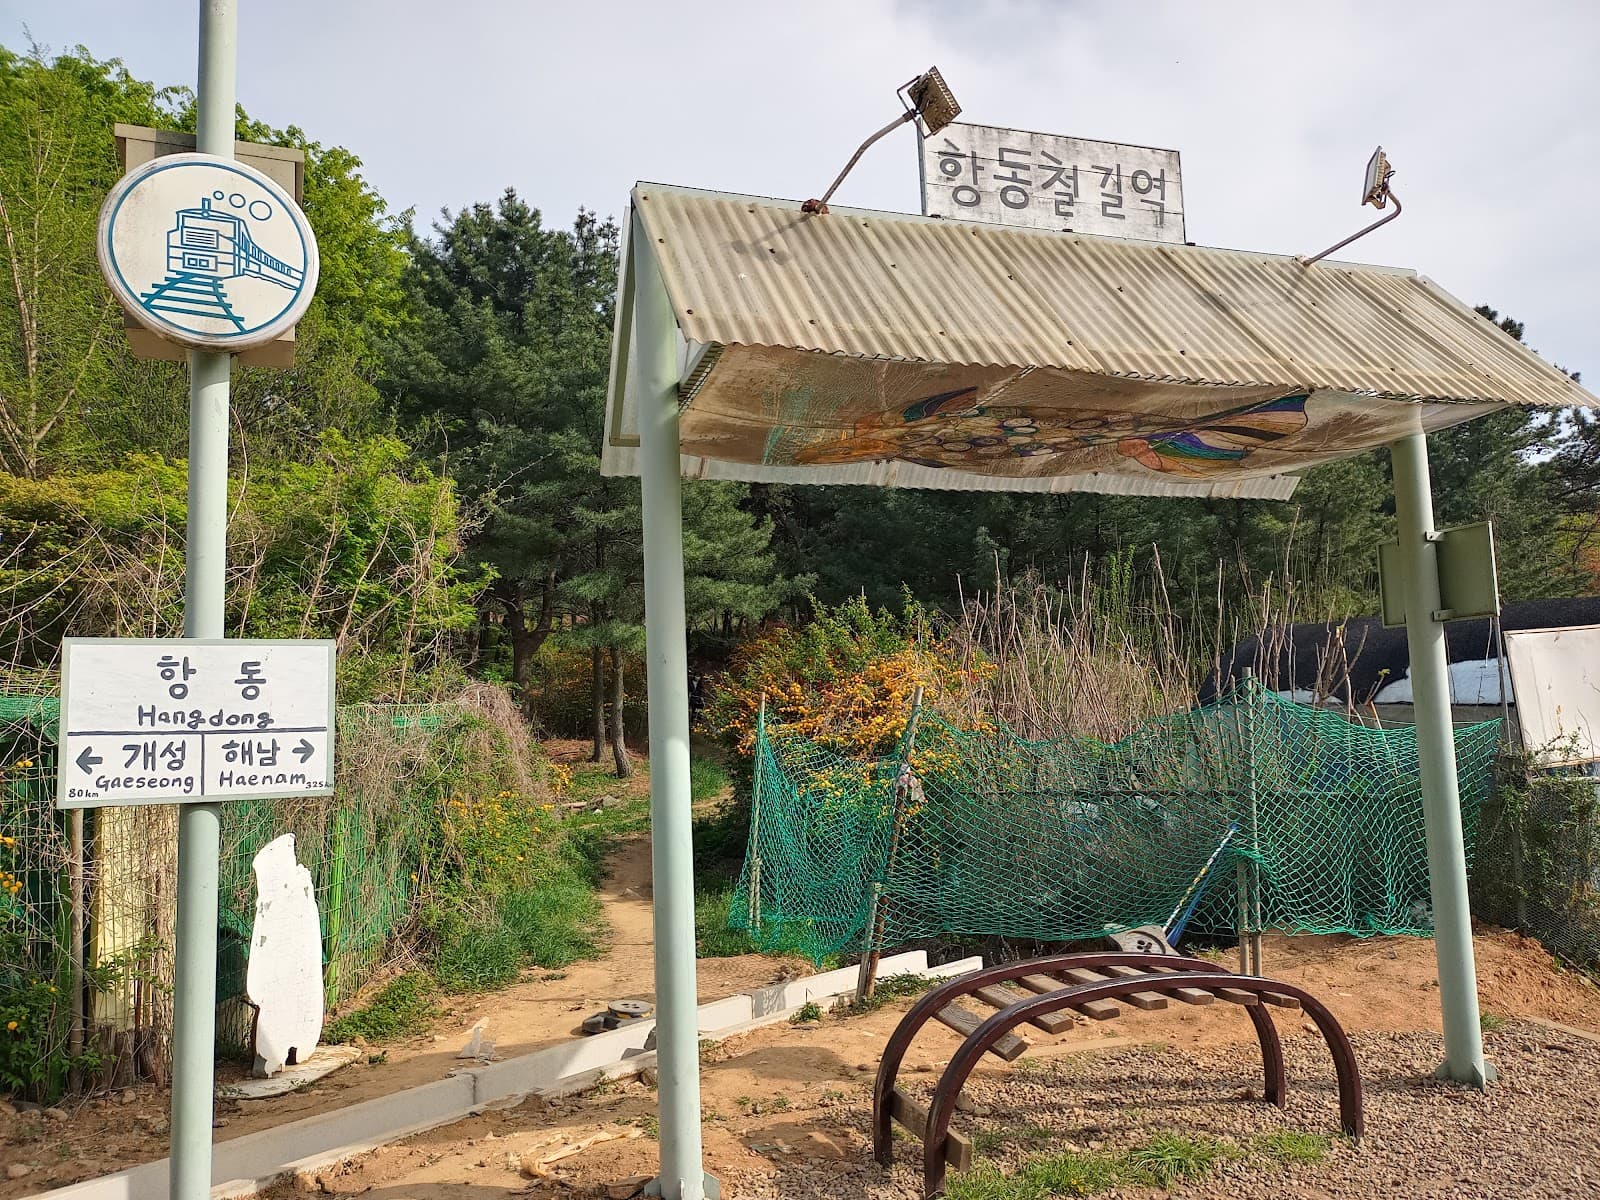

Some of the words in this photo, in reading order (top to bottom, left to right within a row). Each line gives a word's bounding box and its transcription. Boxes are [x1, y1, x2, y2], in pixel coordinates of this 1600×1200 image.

[937, 137, 1166, 227] 항동철길역
[138, 704, 274, 729] Hangdong
[122, 740, 187, 771] 개성
[222, 738, 280, 767] 해남
[95, 775, 194, 794] Gaeseong
[219, 770, 306, 788] Haenam
